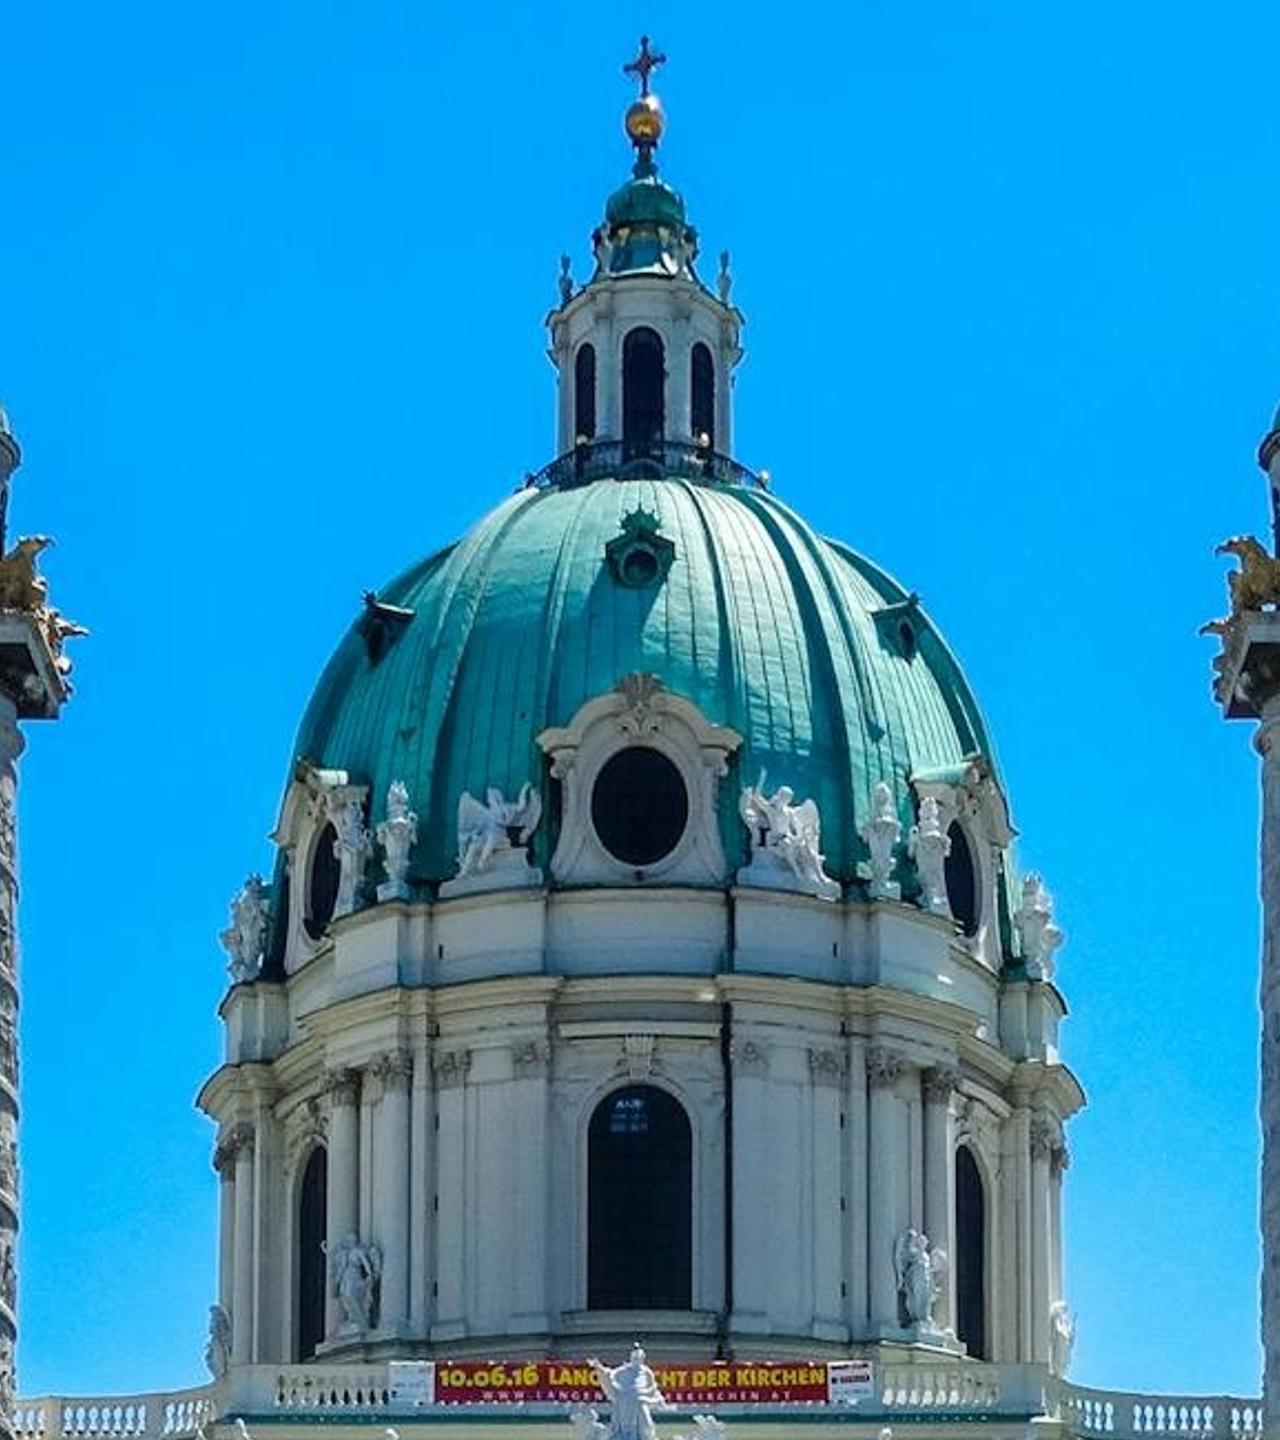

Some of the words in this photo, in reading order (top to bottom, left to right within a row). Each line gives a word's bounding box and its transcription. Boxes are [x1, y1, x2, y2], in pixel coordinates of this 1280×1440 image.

[438, 1366, 539, 1388] 10.06.16
[550, 1368, 601, 1386] LANG
[692, 1369, 730, 1388] DER
[736, 1367, 825, 1387] KIRCHEN
